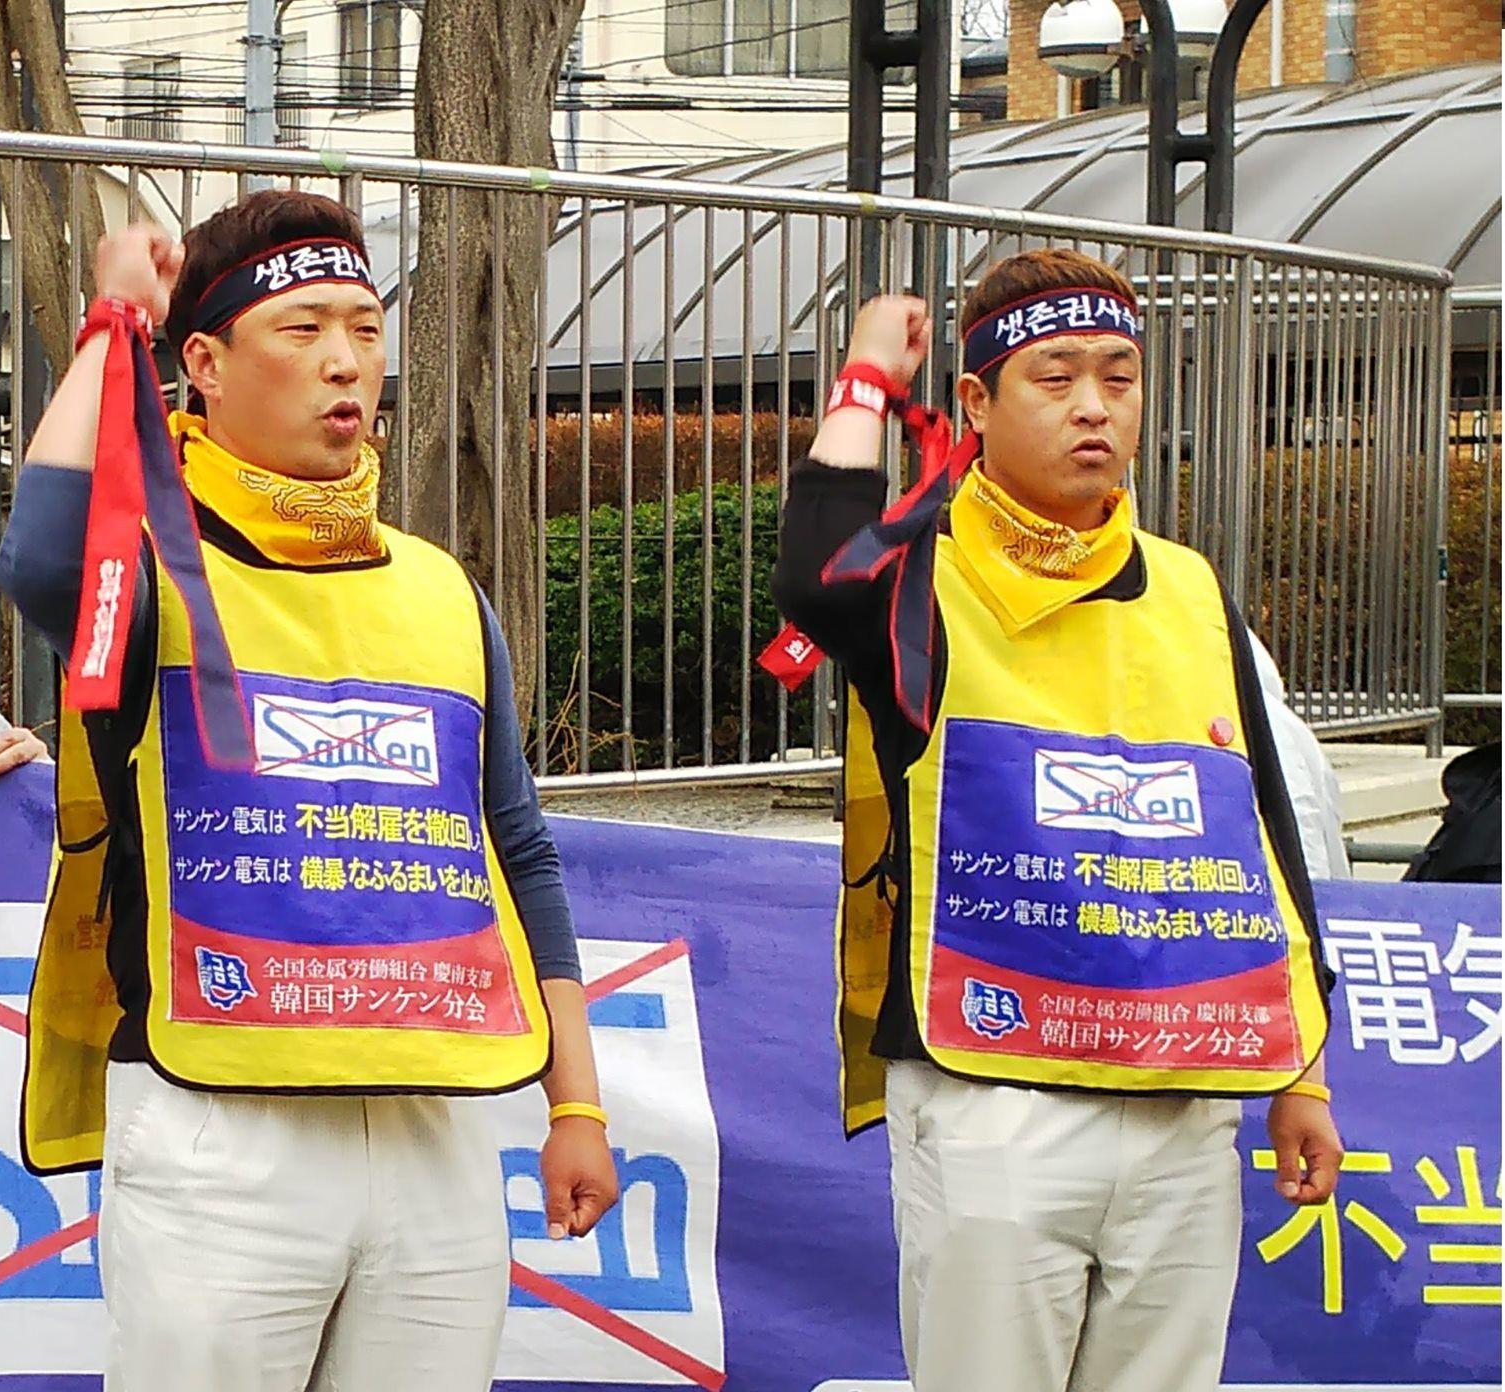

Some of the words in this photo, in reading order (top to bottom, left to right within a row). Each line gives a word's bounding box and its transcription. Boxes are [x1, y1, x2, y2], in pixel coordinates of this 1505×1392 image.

[262, 956, 427, 983] 全国金属労働組合
[432, 959, 493, 990] 慶南支部
[270, 982, 486, 1024] 韓国サンケン分会
[1196, 1002, 1272, 1026] 慶南支部
[1041, 1018, 1264, 1058] 韓国サンケン分会
